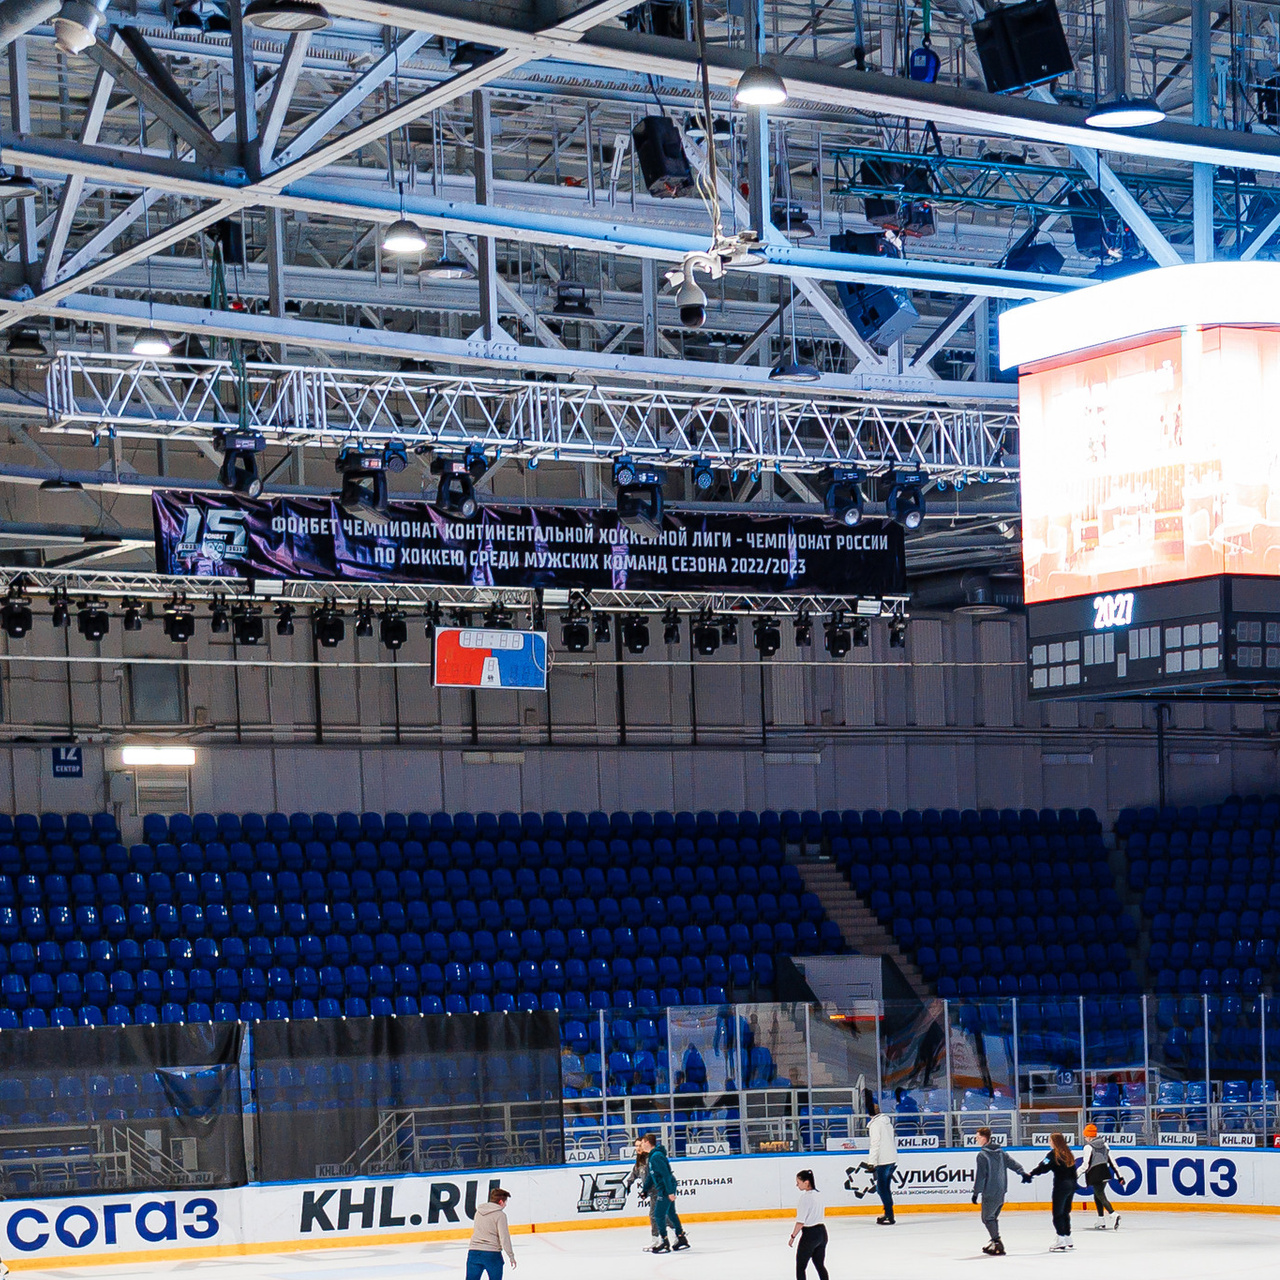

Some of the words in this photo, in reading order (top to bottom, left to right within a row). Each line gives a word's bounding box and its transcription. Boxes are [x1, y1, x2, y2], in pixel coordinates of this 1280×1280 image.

[272, 516, 338, 535] ФОНБЕТ
[344, 519, 438, 540] ЧЕМПИОНАТ
[445, 523, 594, 545] КОНТИНЕНТАЛЬНОЙ
[692, 530, 732, 547] ЛИГИ
[746, 533, 831, 551] ЧЕМПИОНАТ
[836, 535, 889, 551] РОССИИ
[375, 547, 396, 565] ПО
[401, 548, 465, 567] ХОККЕЮ
[469, 550, 520, 570] СРЕДИ
[524, 551, 599, 570] МУЖСКИХ
[603, 553, 668, 574] КОМАНД
[672, 556, 728, 573] СЕЗОНА
[731, 557, 807, 575] 2022/2023
[55, 765, 80, 773] СЕКТОР
[1057, 1071, 1072, 1084] 13
[897, 1138, 936, 1147] KHL.RU
[1035, 1133, 1073, 1145] KHU
[1161, 1135, 1195, 1145] KHL.RU
[1221, 1135, 1254, 1146] KHL.RU
[689, 1144, 727, 1155] LADA
[637, 1177, 733, 1189] КЕНТАЛЬНАЯ
[300, 1179, 501, 1233] KHL.RU
